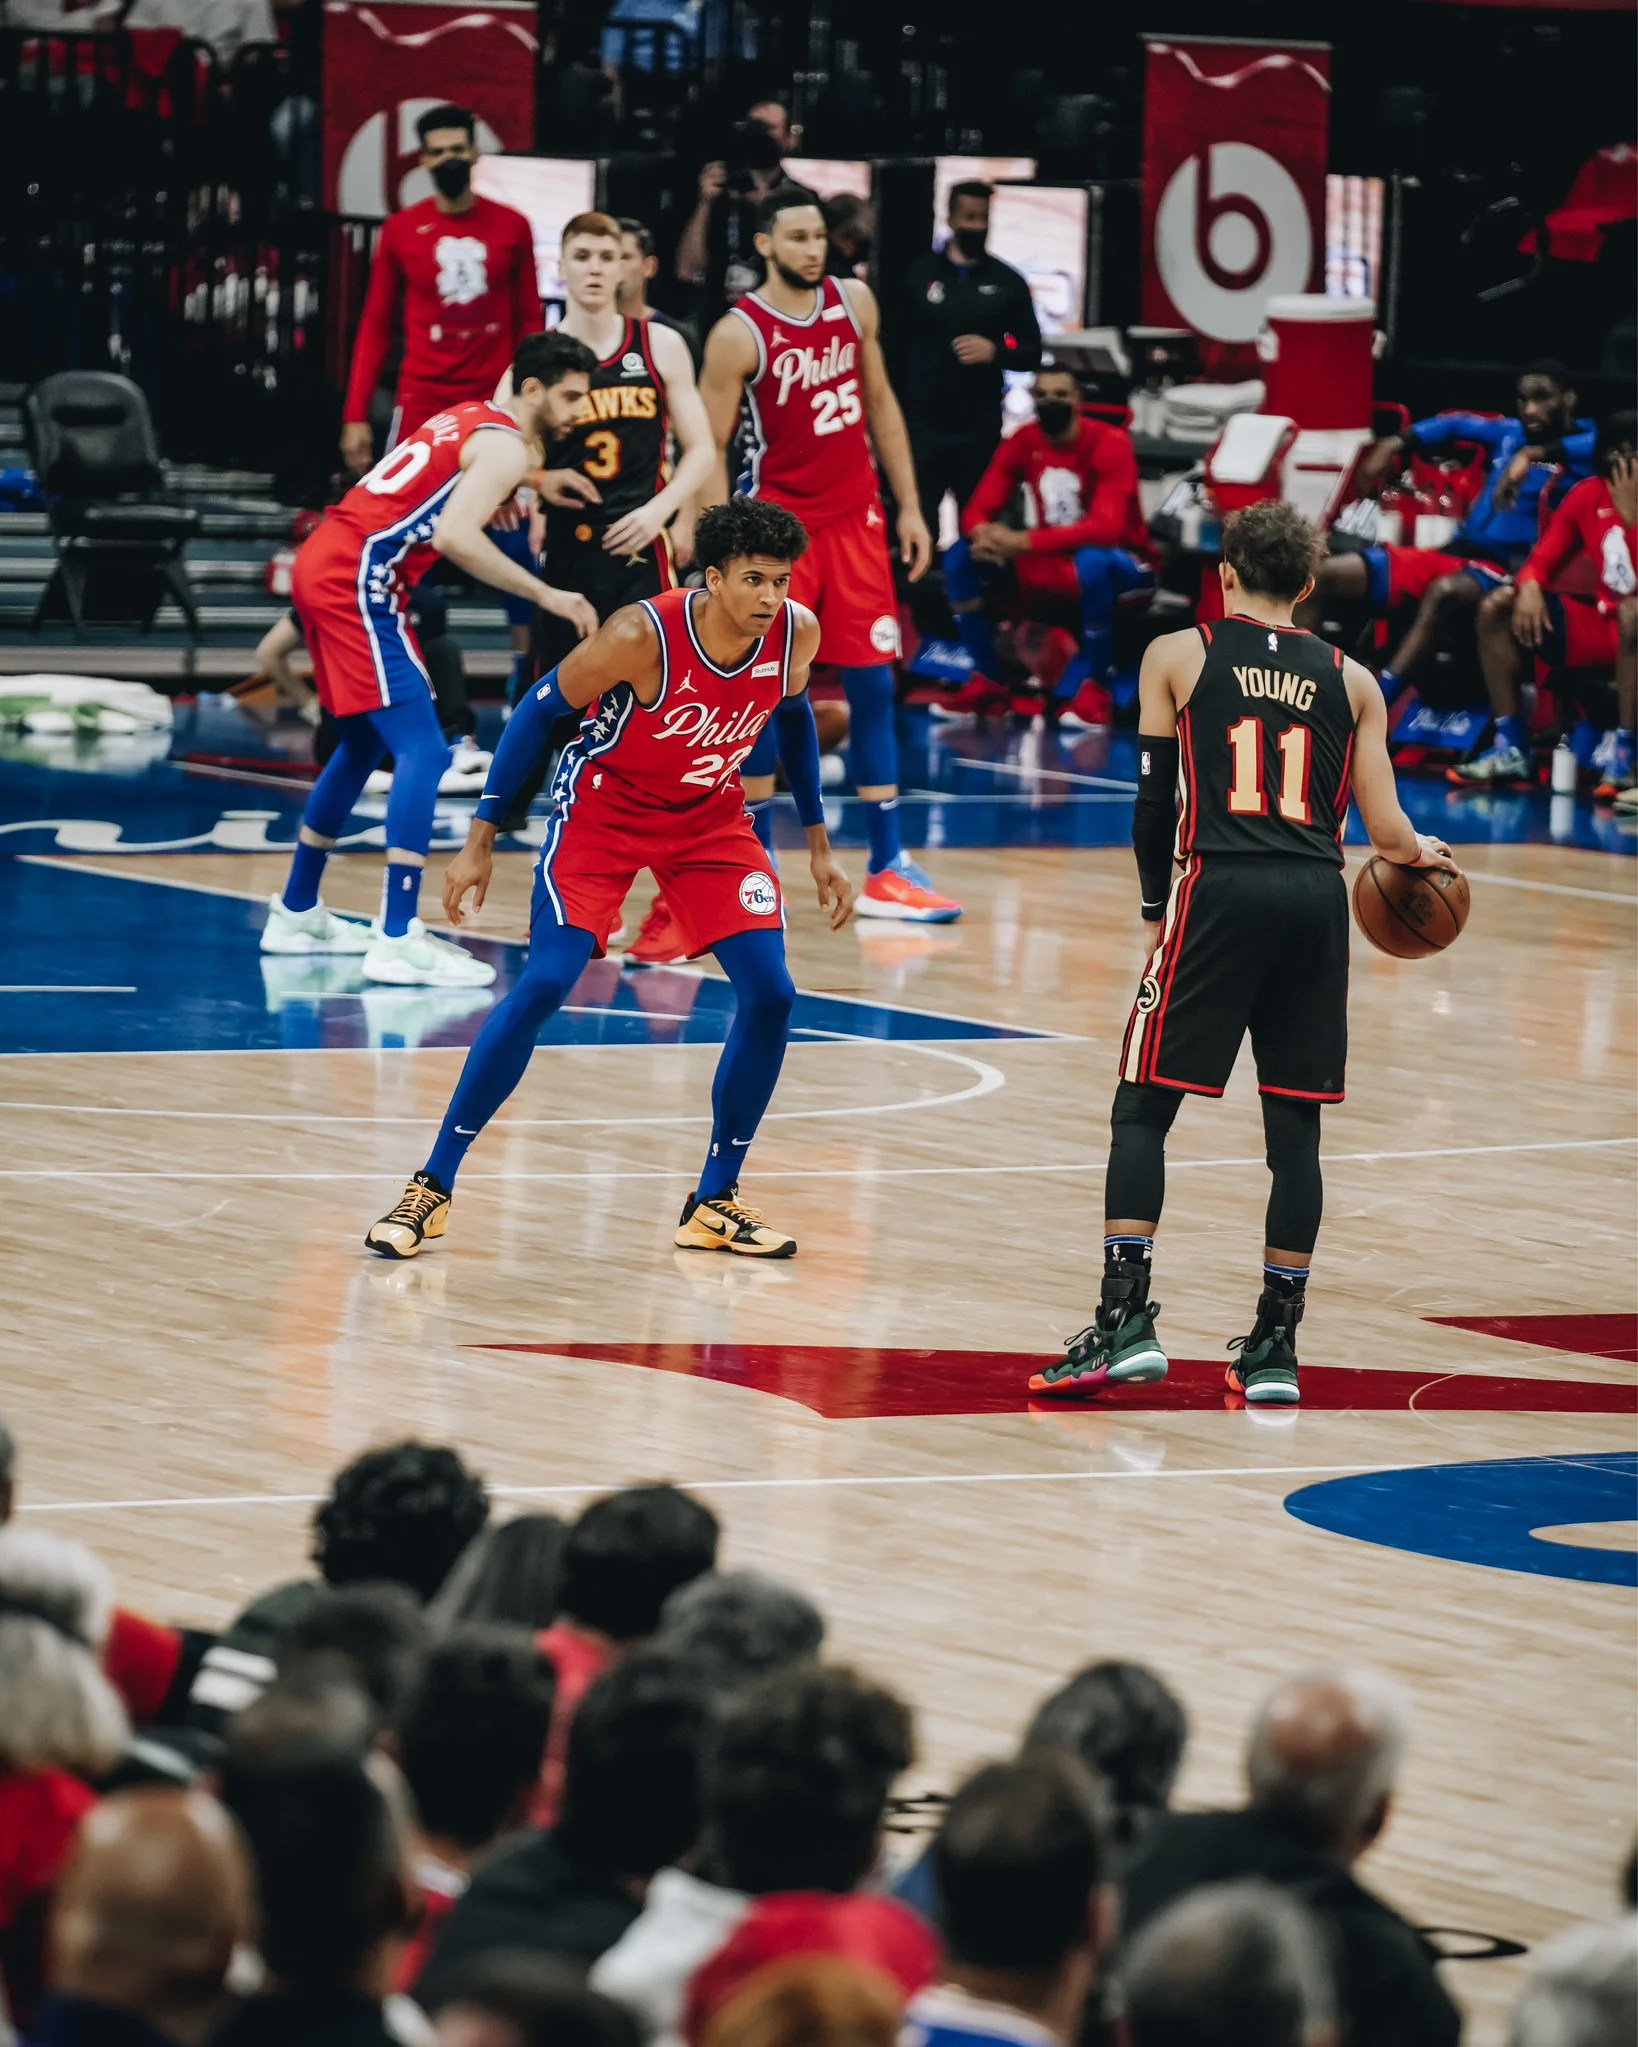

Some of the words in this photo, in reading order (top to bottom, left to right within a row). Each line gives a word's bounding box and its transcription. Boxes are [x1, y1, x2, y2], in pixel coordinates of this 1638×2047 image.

[771, 335, 857, 408] Phila
[575, 385, 657, 426] AWKS
[810, 378, 863, 436] 25
[583, 430, 621, 480] 3
[1232, 666, 1317, 712] YOUNG
[651, 700, 770, 748] Phila
[1226, 716, 1314, 825] 11
